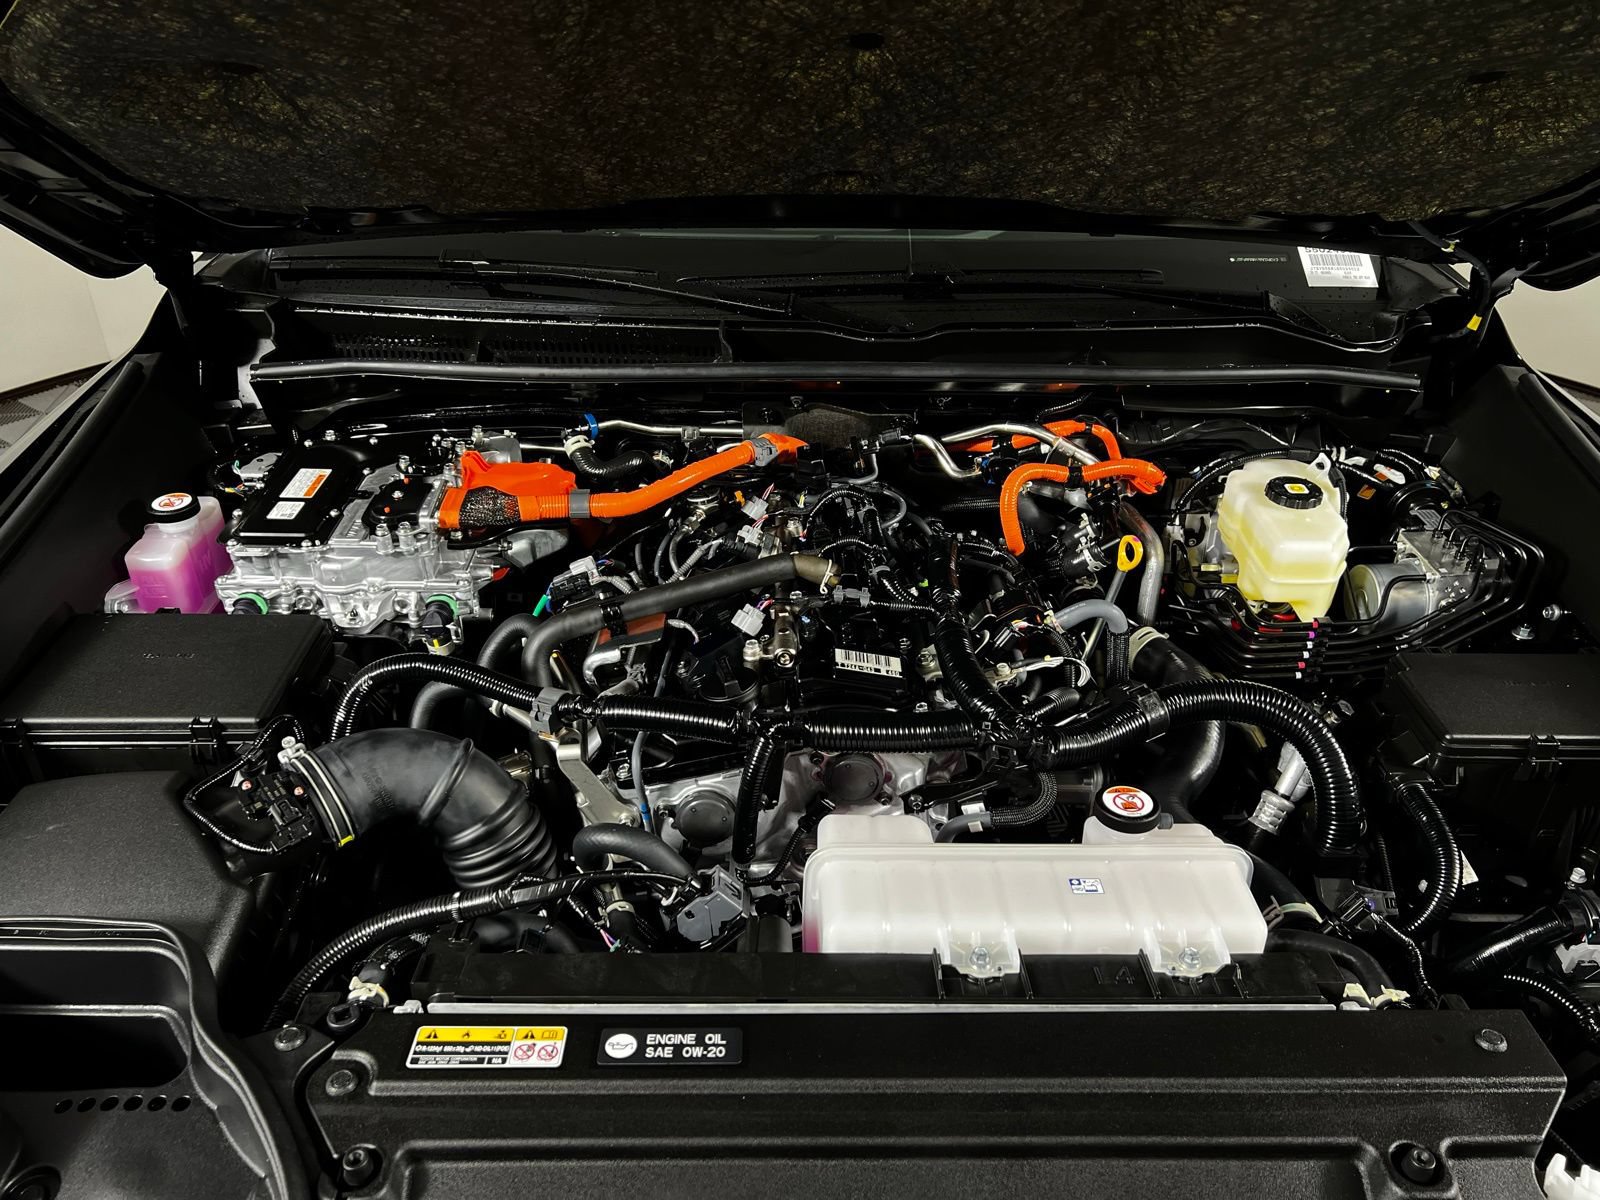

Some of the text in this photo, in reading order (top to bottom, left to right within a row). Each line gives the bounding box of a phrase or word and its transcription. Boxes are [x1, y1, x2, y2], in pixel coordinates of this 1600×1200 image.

[646, 1033, 727, 1045] ENGINE OIL
[645, 1046, 726, 1058] SAE 0W-20
